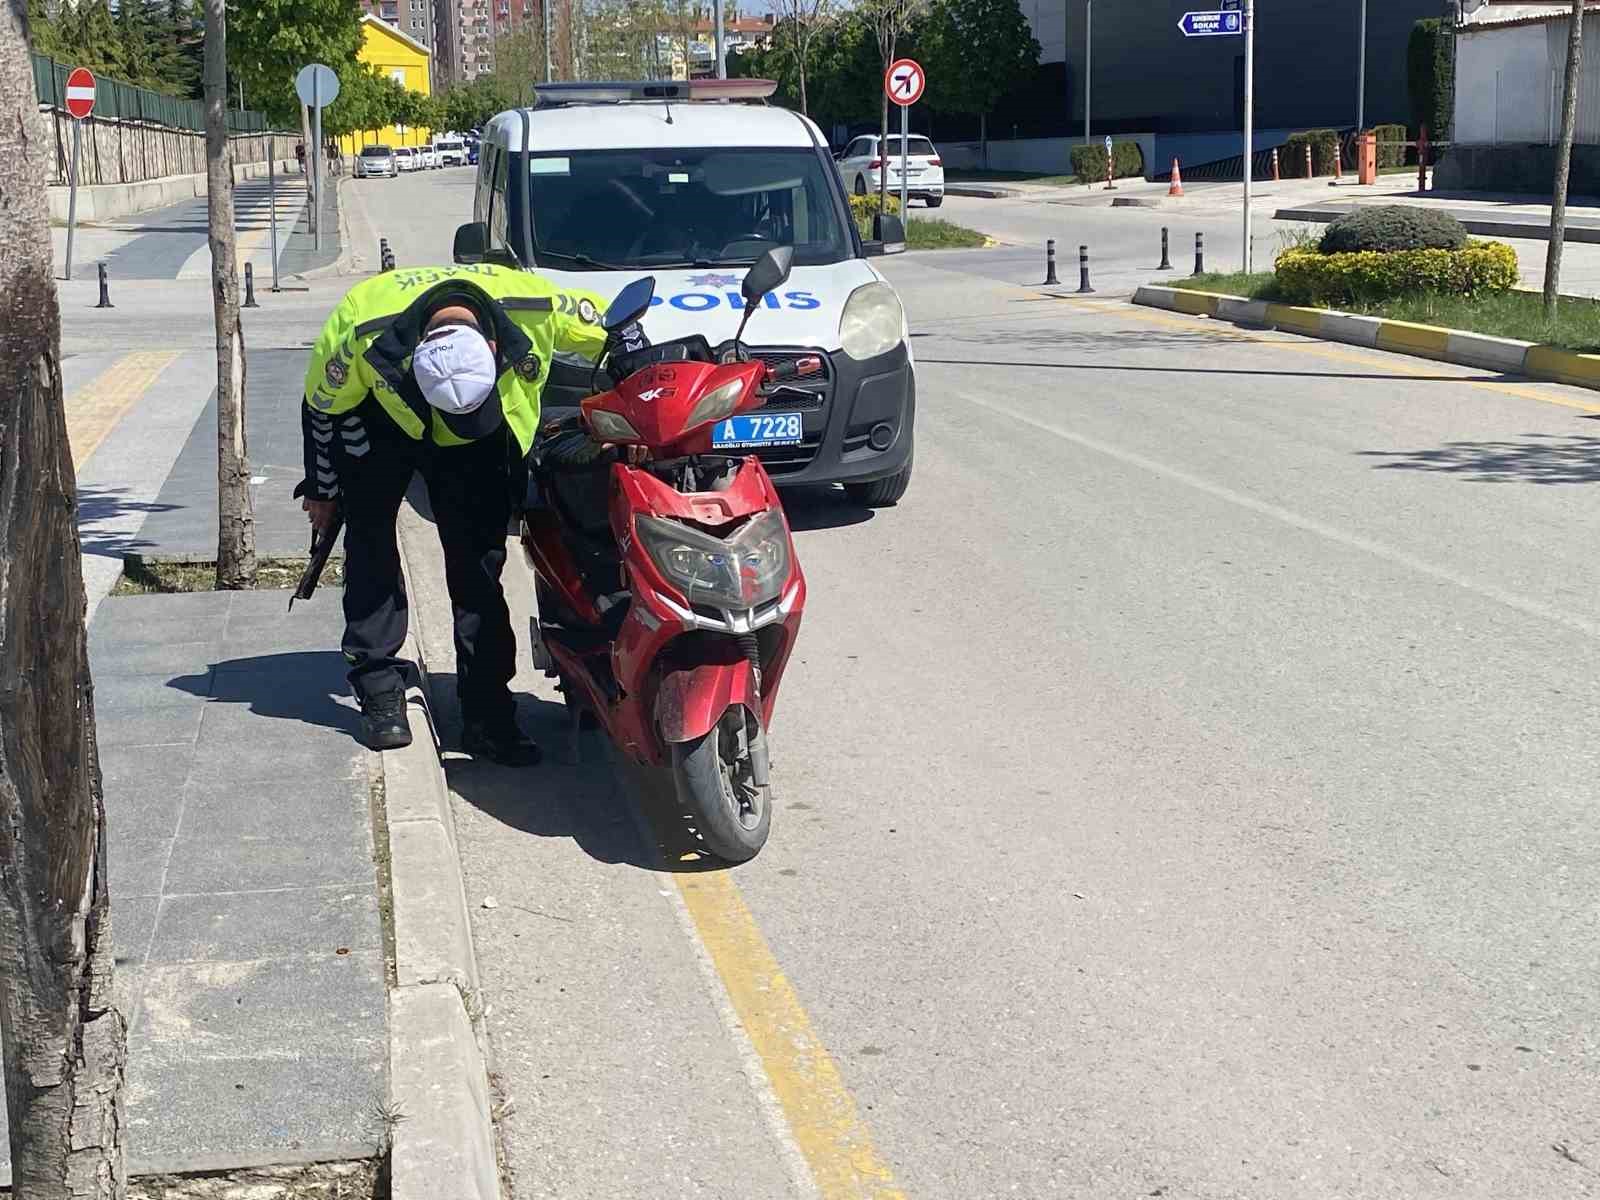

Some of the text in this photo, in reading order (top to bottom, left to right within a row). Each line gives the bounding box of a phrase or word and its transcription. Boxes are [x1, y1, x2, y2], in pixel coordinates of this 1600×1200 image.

[1193, 21, 1219, 29] SOKAK
[723, 416, 799, 440] A 7228
